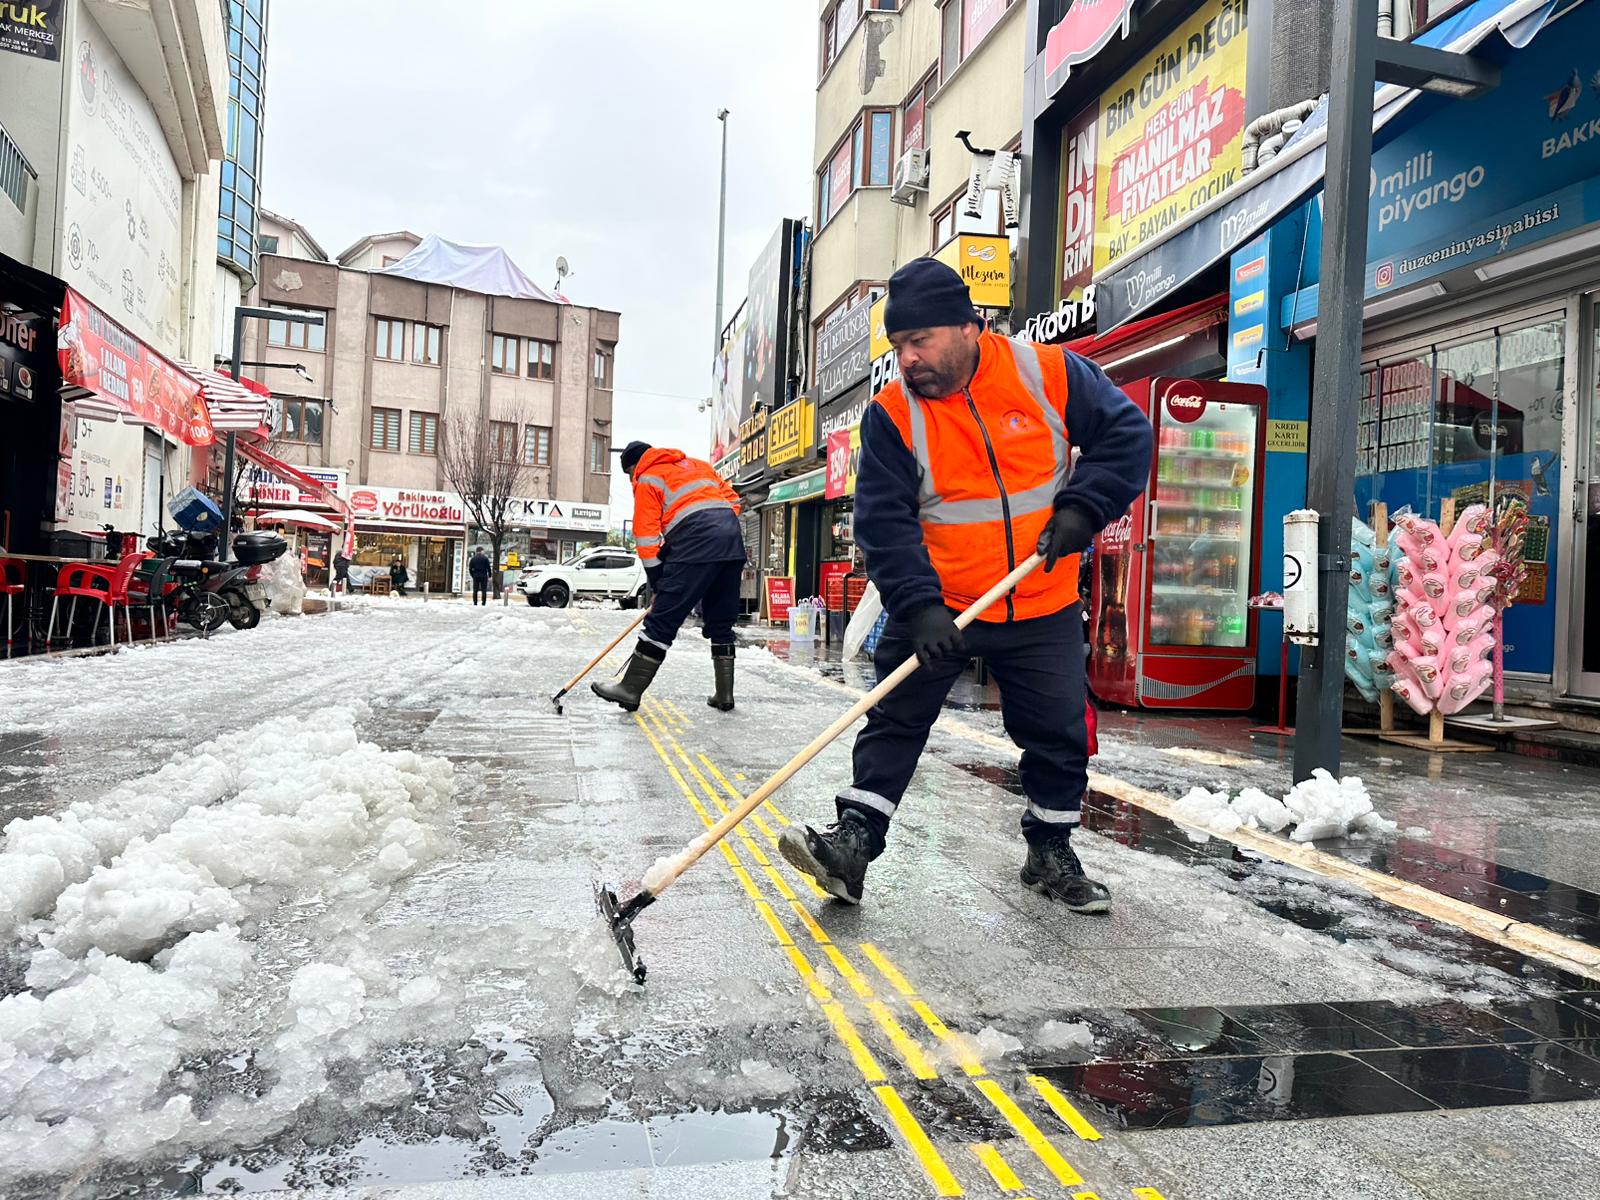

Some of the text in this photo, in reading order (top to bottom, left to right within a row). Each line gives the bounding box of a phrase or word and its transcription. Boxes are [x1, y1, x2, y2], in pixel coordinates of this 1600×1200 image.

[1106, 88, 1135, 138] BİR
[1139, 46, 1182, 110] GÜN
[1145, 87, 1194, 140] HER GÜN
[1117, 86, 1225, 193] İNANILMAZ
[1121, 138, 1211, 225] FİYATLAR
[1378, 165, 1485, 232] piyango
[1380, 150, 1433, 198] milli
[1109, 230, 1130, 260] BAY
[1139, 202, 1178, 244] BAYAN
[1398, 203, 1559, 275] duzceninyasinabisi
[961, 264, 1006, 283] Mezura
[770, 406, 799, 447] EYFEL
[382, 501, 462, 521] Yörükoğlu
[398, 491, 446, 503] Baklavacı
